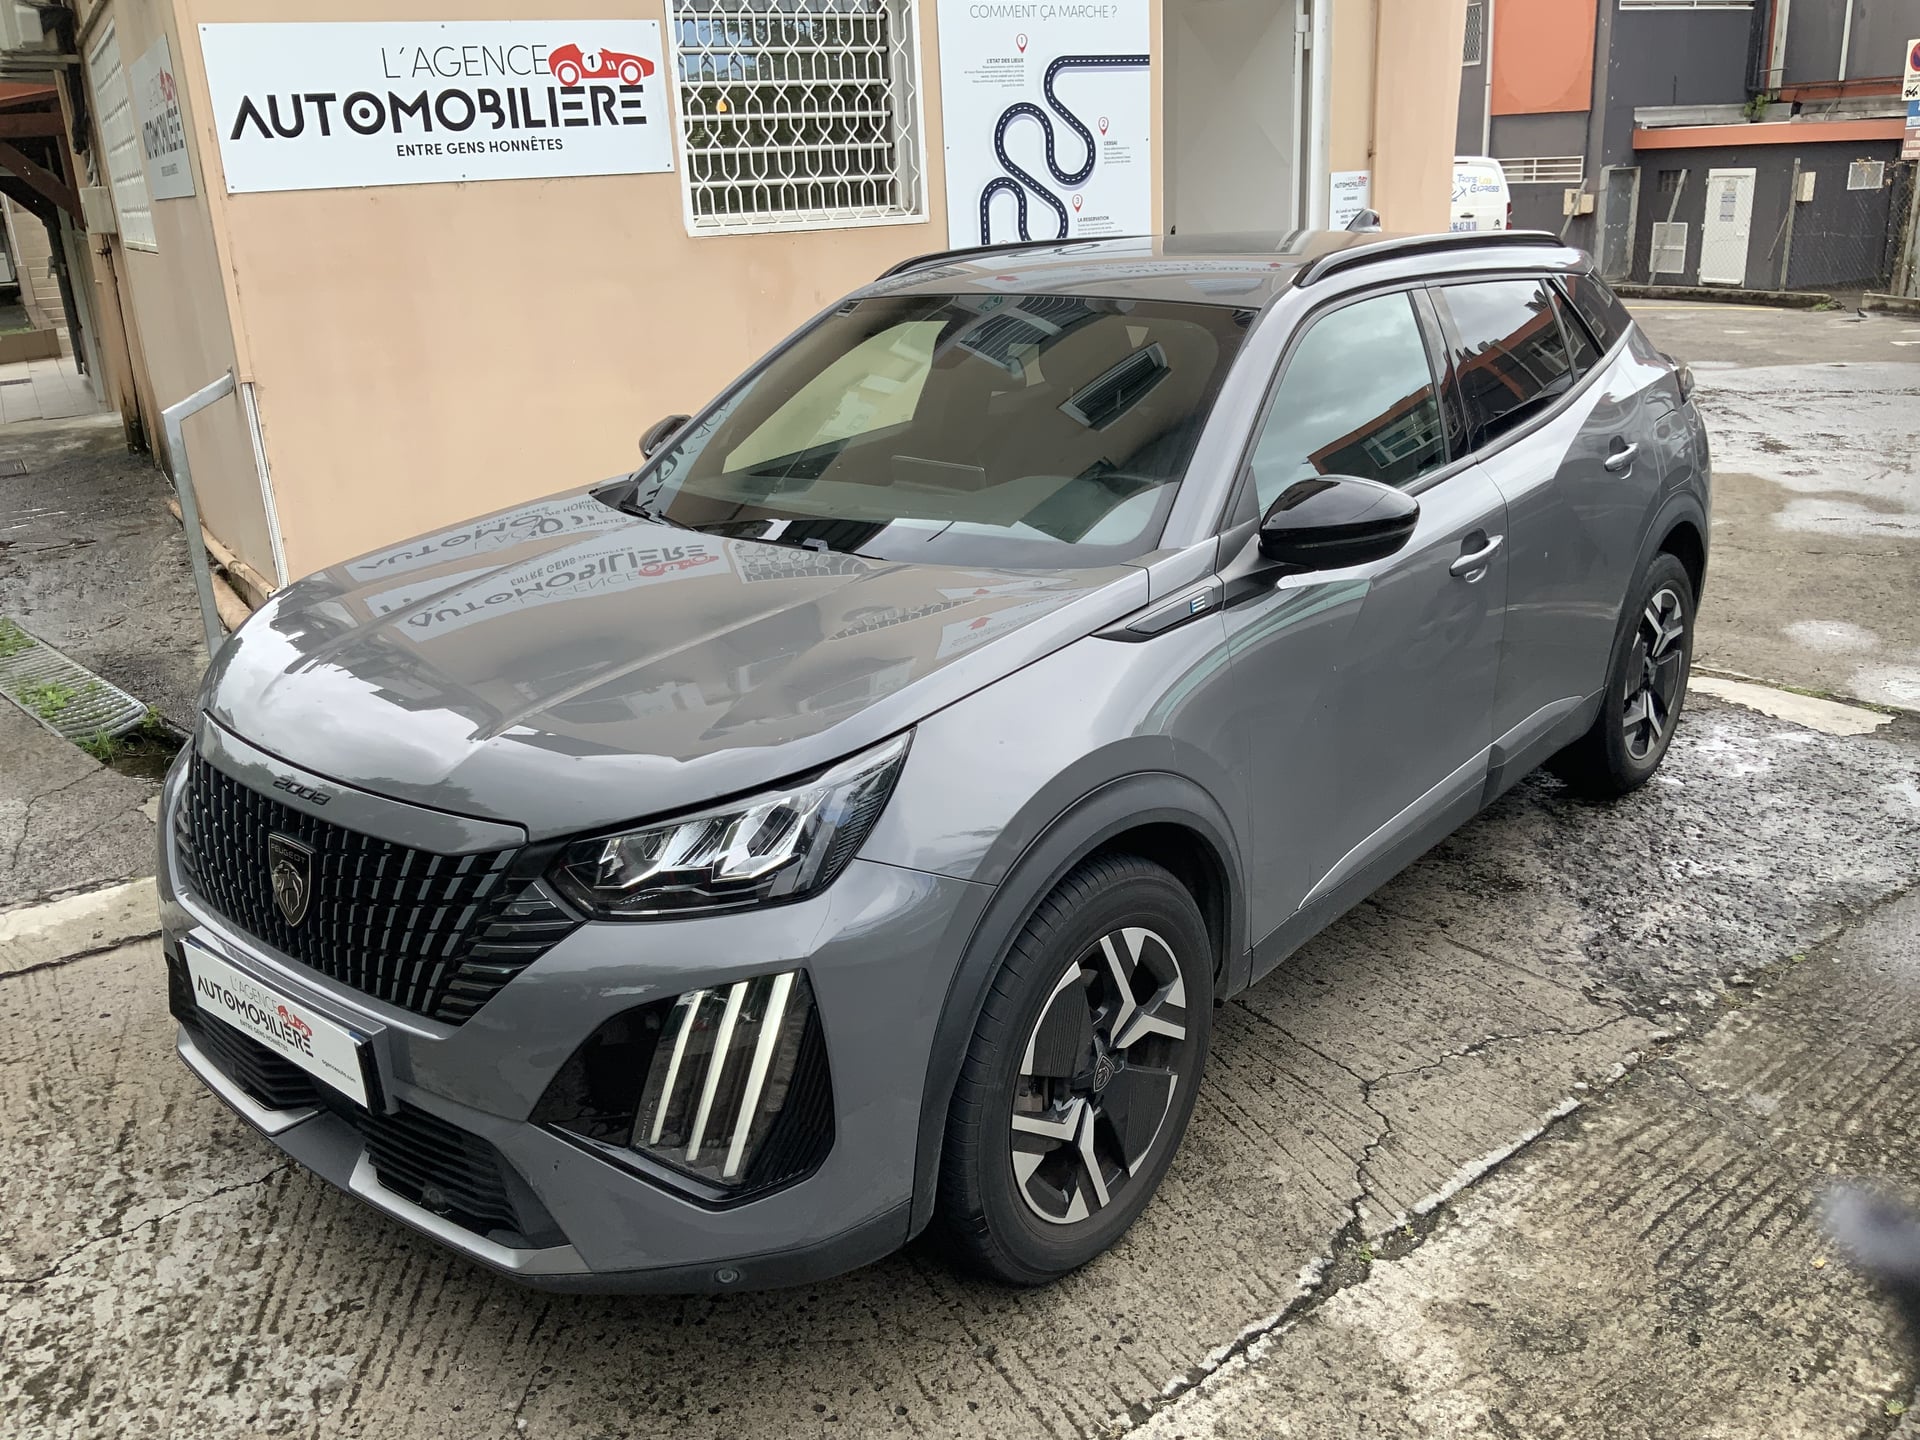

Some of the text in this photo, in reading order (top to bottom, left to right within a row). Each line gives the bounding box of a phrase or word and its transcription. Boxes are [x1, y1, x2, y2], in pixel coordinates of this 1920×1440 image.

[969, 4, 1037, 19] COMMENT
[1040, 4, 1056, 21] ÇA
[1058, 4, 1109, 19] MARCHE
[381, 44, 551, 79] L'AGENCE
[587, 54, 595, 69] 1
[396, 136, 564, 157] ENTRE GENS HONNÊTES
[272, 777, 332, 806] 2008
[270, 842, 306, 864] PEUGEOT
[229, 975, 280, 1012] L'AGENCE
